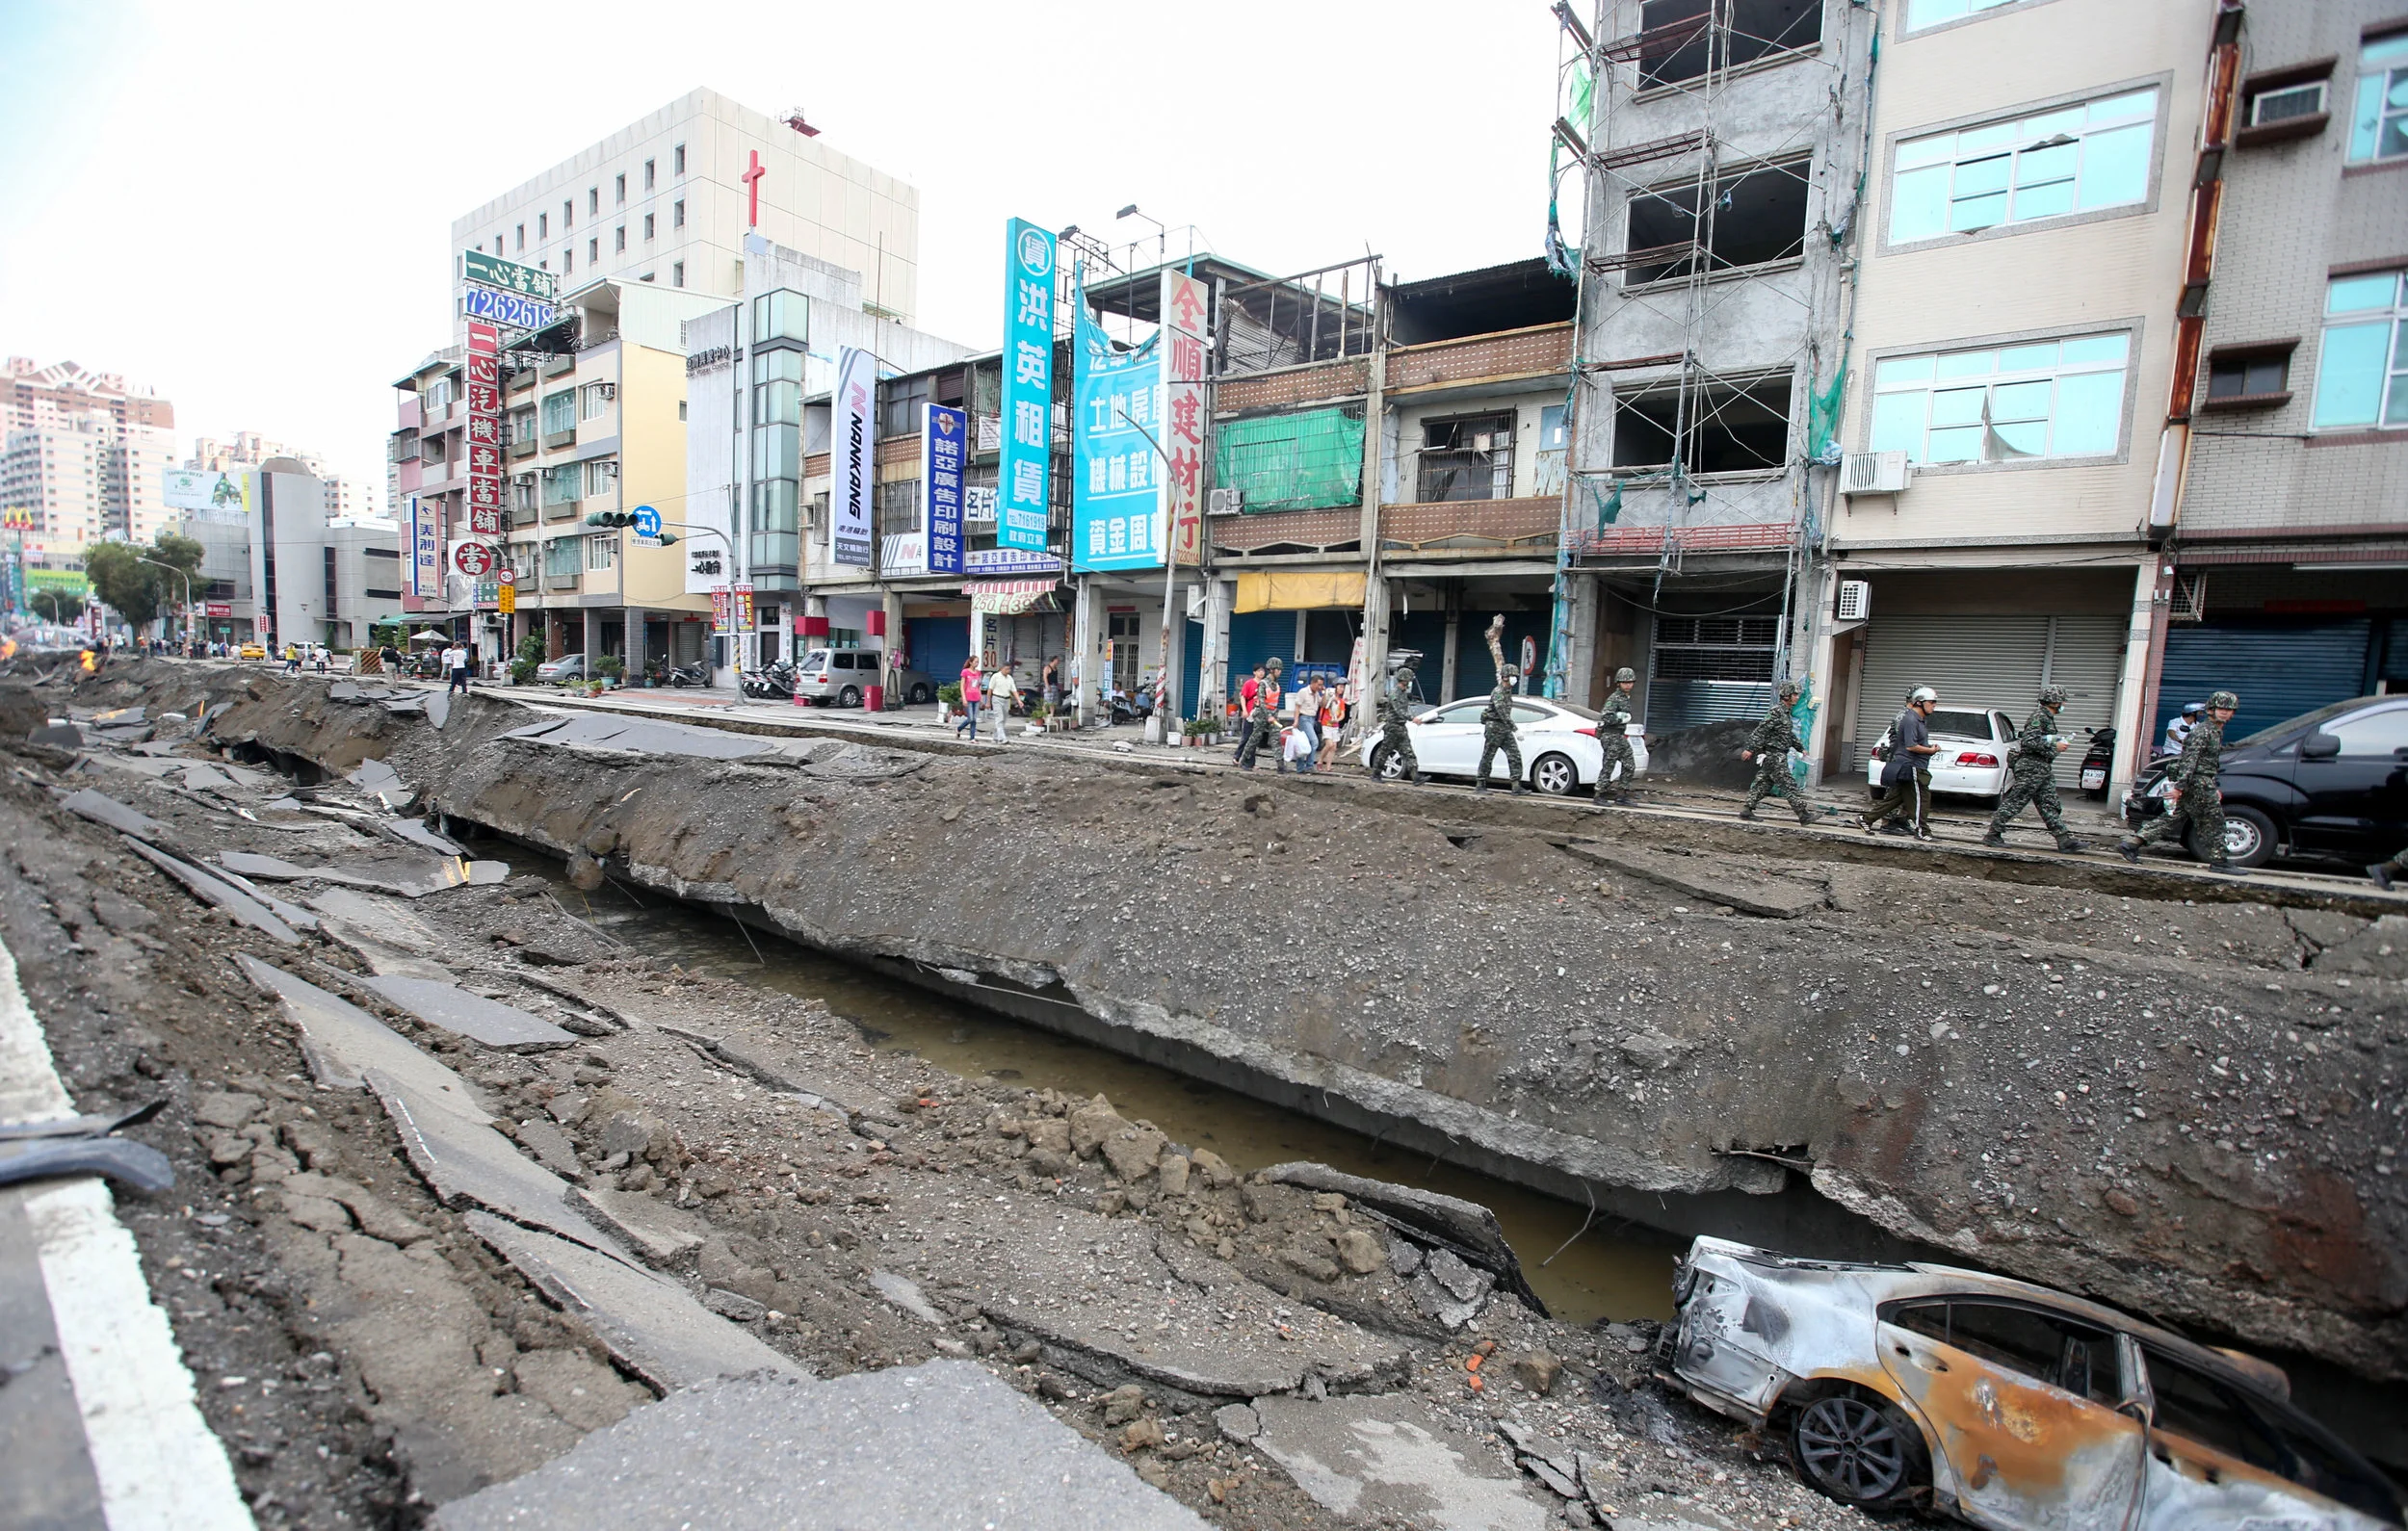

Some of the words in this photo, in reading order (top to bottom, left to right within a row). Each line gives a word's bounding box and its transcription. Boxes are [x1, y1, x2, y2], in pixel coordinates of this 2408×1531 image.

[467, 288, 554, 328] 7262618
[1013, 278, 1049, 506] 洪英租賃
[470, 331, 499, 533] 一心汽機車當舖
[849, 411, 863, 521] NANKANG
[933, 436, 958, 568] 諾亞廣告印刷設計
[967, 489, 994, 519] 名片
[459, 544, 488, 575] 當
[974, 597, 996, 612] 250
[984, 617, 998, 650] 名片
[982, 650, 998, 668] 30
